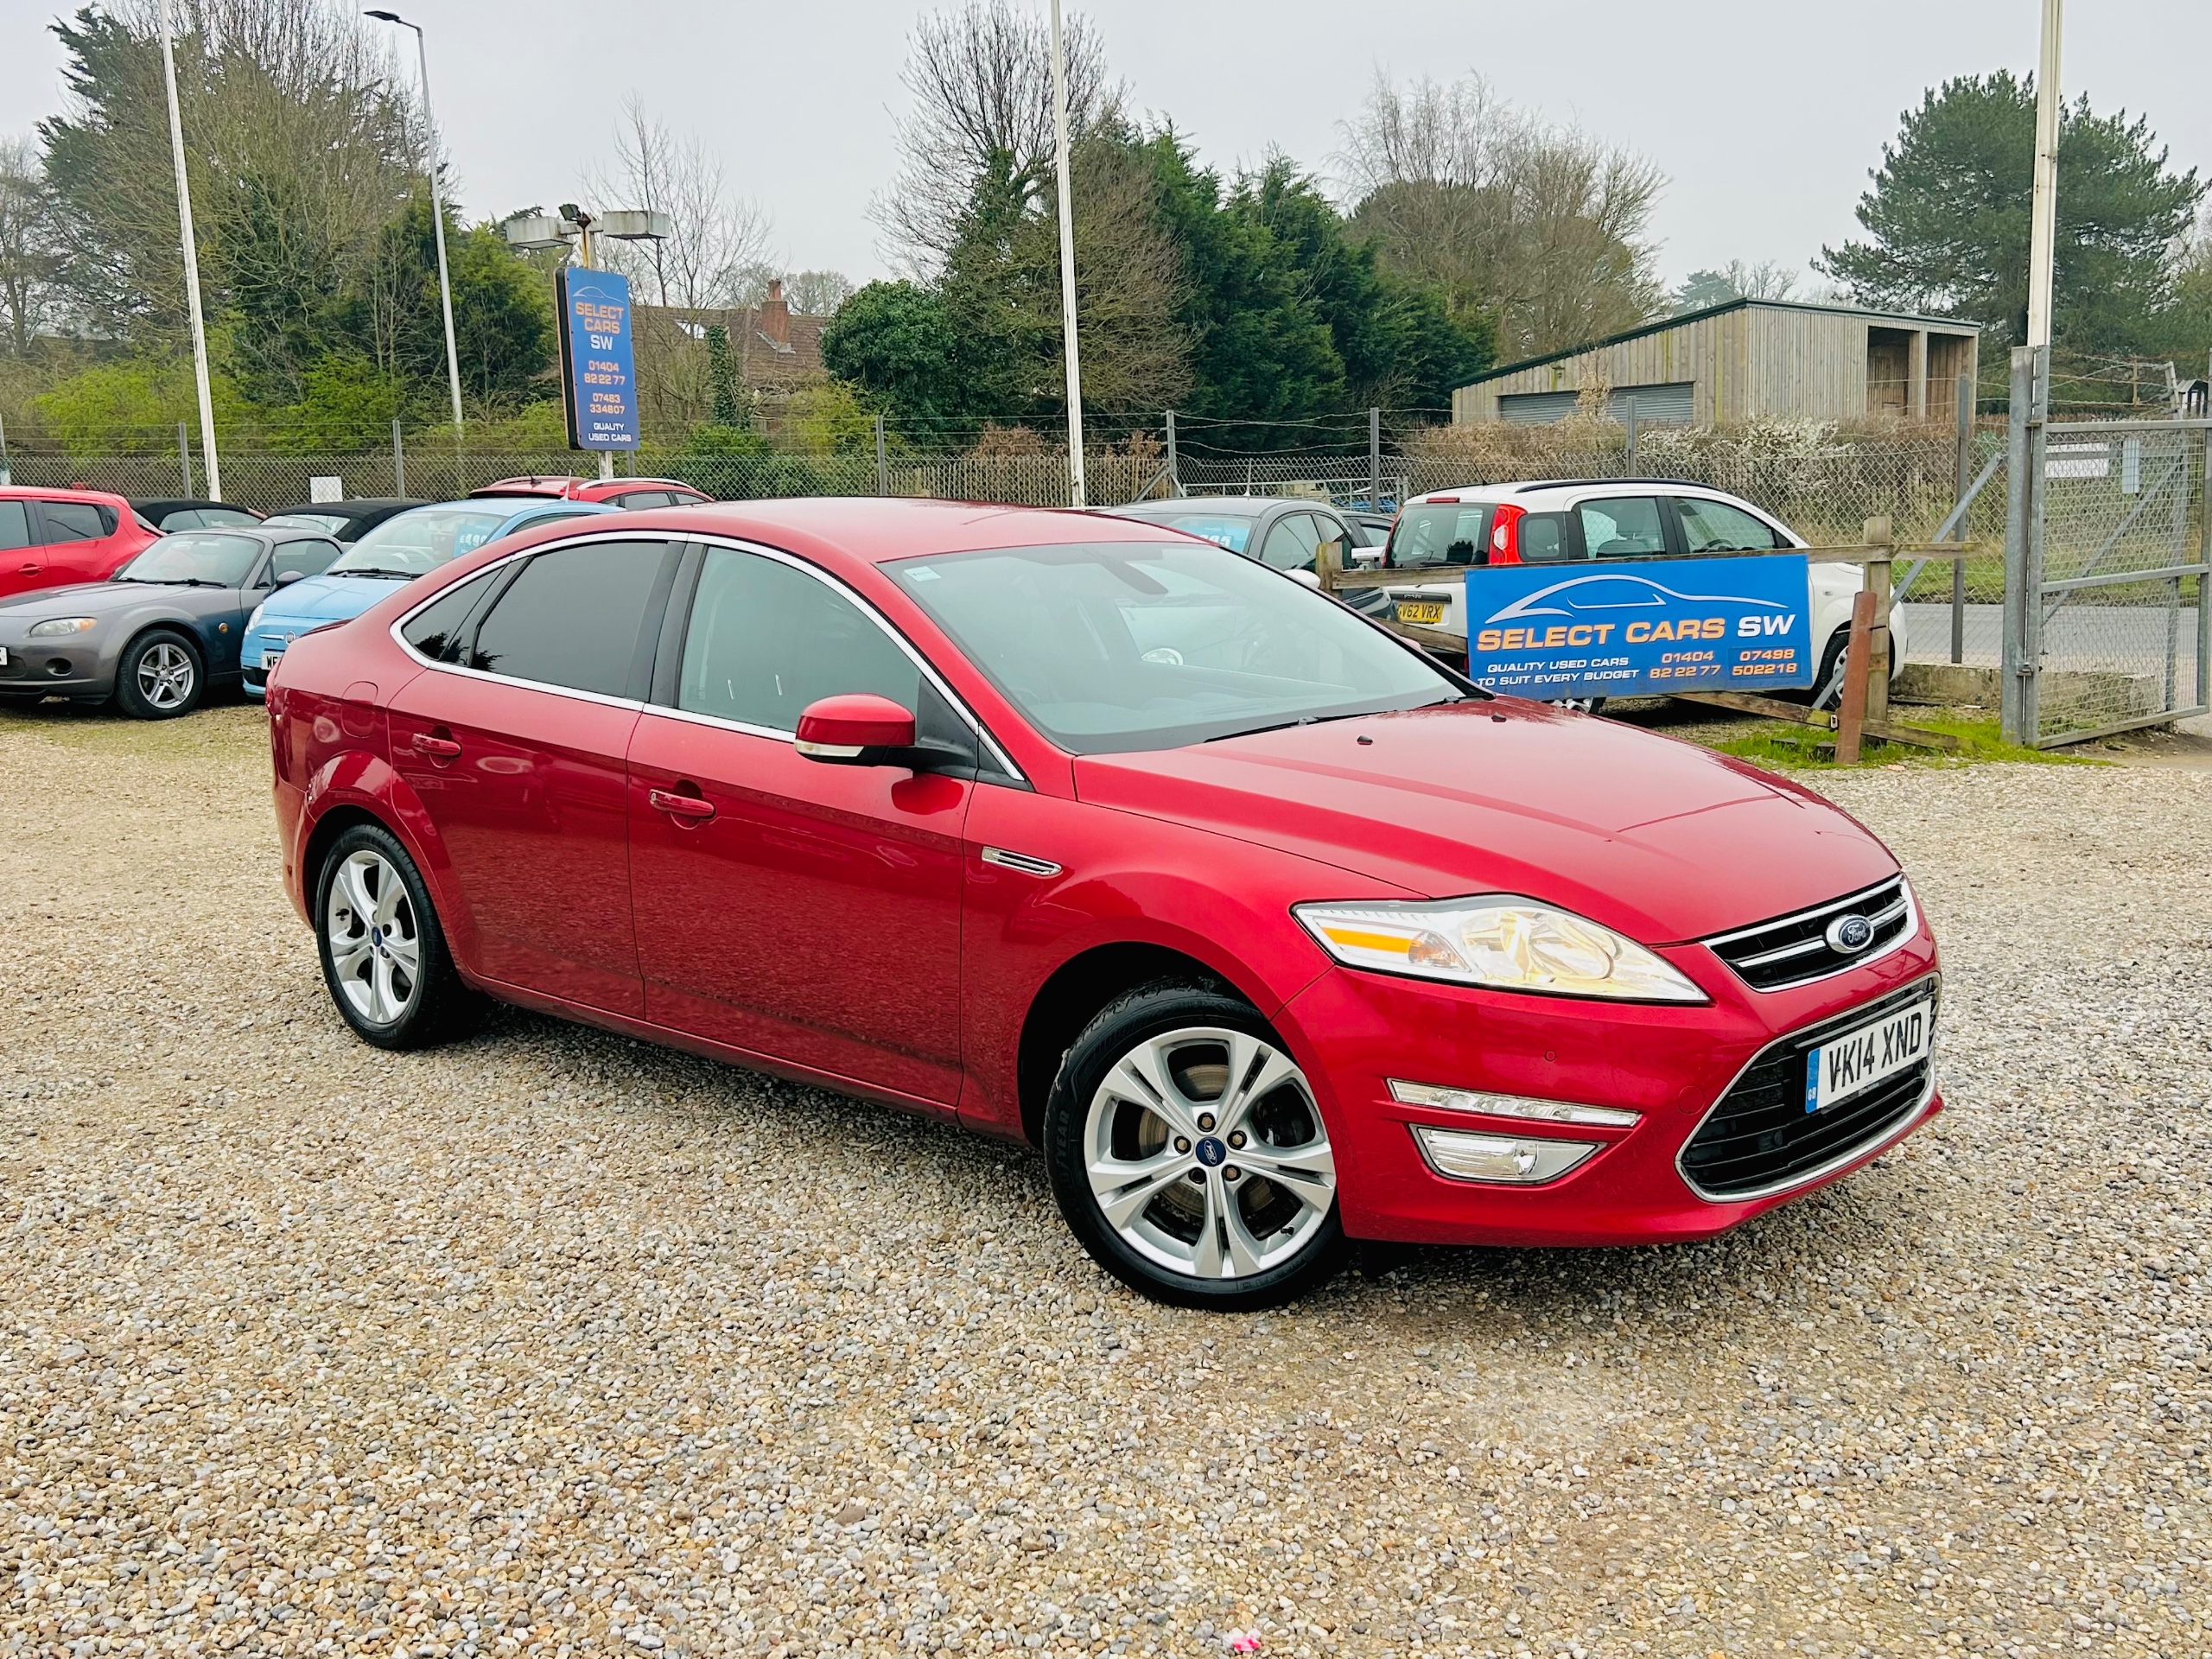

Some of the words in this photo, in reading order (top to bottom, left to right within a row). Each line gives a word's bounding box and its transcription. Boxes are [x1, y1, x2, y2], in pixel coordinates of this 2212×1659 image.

[575, 302, 624, 319] SELECT
[584, 318, 620, 334] CARS
[590, 334, 613, 350] SW
[588, 360, 620, 372] 01404
[592, 392, 620, 404] 07483
[593, 422, 625, 431] QUALITY
[588, 433, 610, 442] USED
[611, 434, 632, 442] CARS
[1421, 605, 1440, 620] VRX
[1477, 624, 1615, 652] SELECT
[1625, 617, 1726, 645] CARS
[1737, 613, 1796, 638] SW
[1661, 651, 1714, 664] 01404
[1739, 649, 1796, 662] 07498
[1487, 661, 1546, 673] QUALITY
[1549, 659, 1587, 670] USED
[1591, 657, 1629, 668] CARS
[1649, 667, 1672, 679] 82
[1674, 665, 1697, 677] 22
[1700, 664, 1721, 676] 77
[1732, 663, 1797, 676] 502218
[1478, 677, 1496, 687] TO
[1499, 675, 1532, 685] SUIT
[1534, 672, 1580, 683] EVERY
[1583, 670, 1639, 681] BUDGET
[1847, 924, 1867, 944] Ford
[1828, 1032, 1875, 1093] VK14
[1880, 1012, 1922, 1069] XND
[1808, 1086, 1817, 1101] GB
